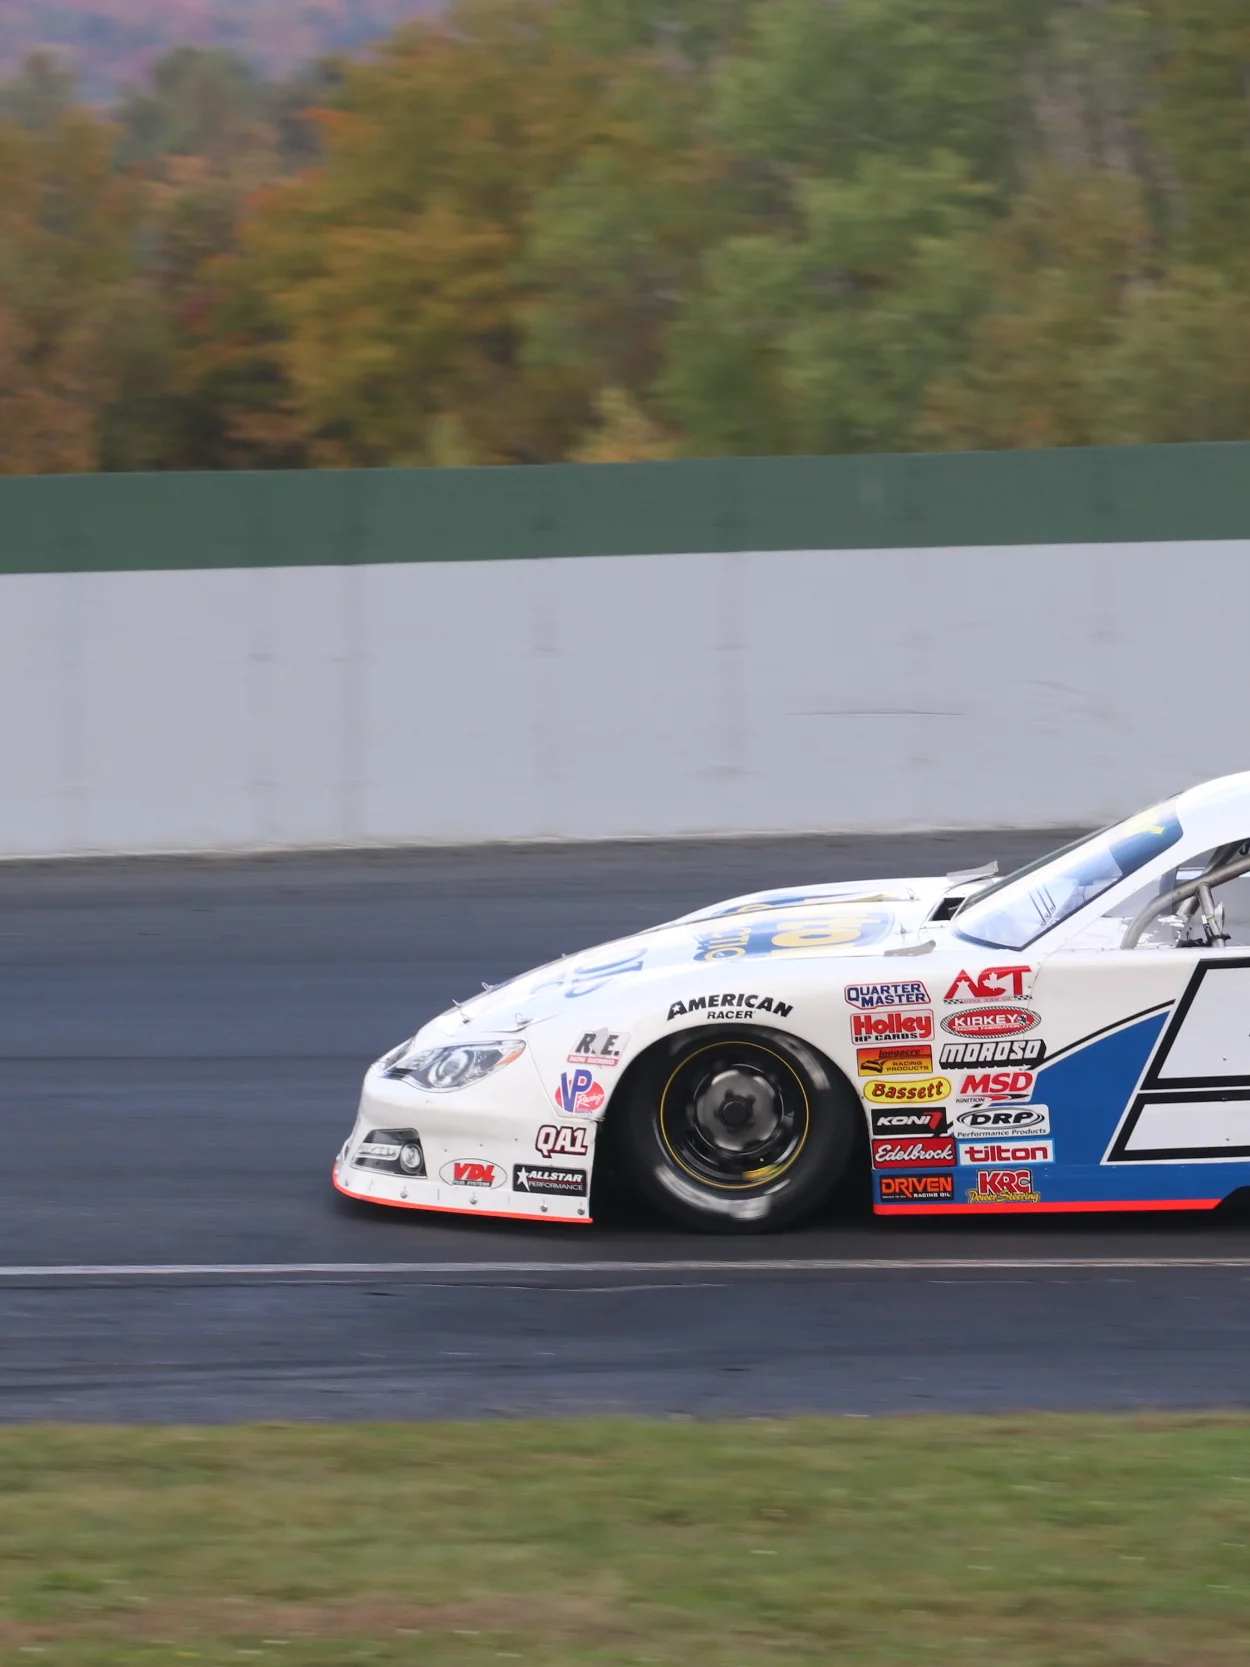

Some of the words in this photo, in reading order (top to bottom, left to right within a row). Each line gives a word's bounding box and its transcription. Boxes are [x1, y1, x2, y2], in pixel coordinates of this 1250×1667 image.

[847, 983, 922, 1002] QUARTER
[944, 966, 1032, 1000] ACT
[666, 993, 794, 1021] AMERICAN
[861, 993, 926, 1008] MASTER
[706, 1010, 753, 1020] RACER
[954, 1013, 1019, 1027] KIRKEY
[853, 1013, 932, 1038] Holley
[875, 1033, 918, 1041] CARBS
[941, 1040, 1044, 1066] MOROSO
[560, 1069, 593, 1113] VP
[872, 1081, 945, 1100] Bassett
[960, 1072, 1034, 1095] MSD
[876, 1114, 933, 1127] KONI
[970, 1111, 1034, 1126] DRP
[535, 1124, 588, 1159] QA1
[957, 1129, 1010, 1138] Performance
[1011, 1128, 1047, 1136] Products
[875, 1143, 954, 1163] Edelbrock
[964, 1145, 1049, 1163] tilton
[454, 1162, 496, 1182] VDL
[528, 1170, 583, 1183] ALLSTAR
[528, 1181, 584, 1191] PERFORMANCE
[881, 1176, 953, 1198] DRIVEN
[977, 1169, 1032, 1195] KRC
[966, 1188, 997, 1205] Power
[997, 1188, 1040, 1204] Steering
